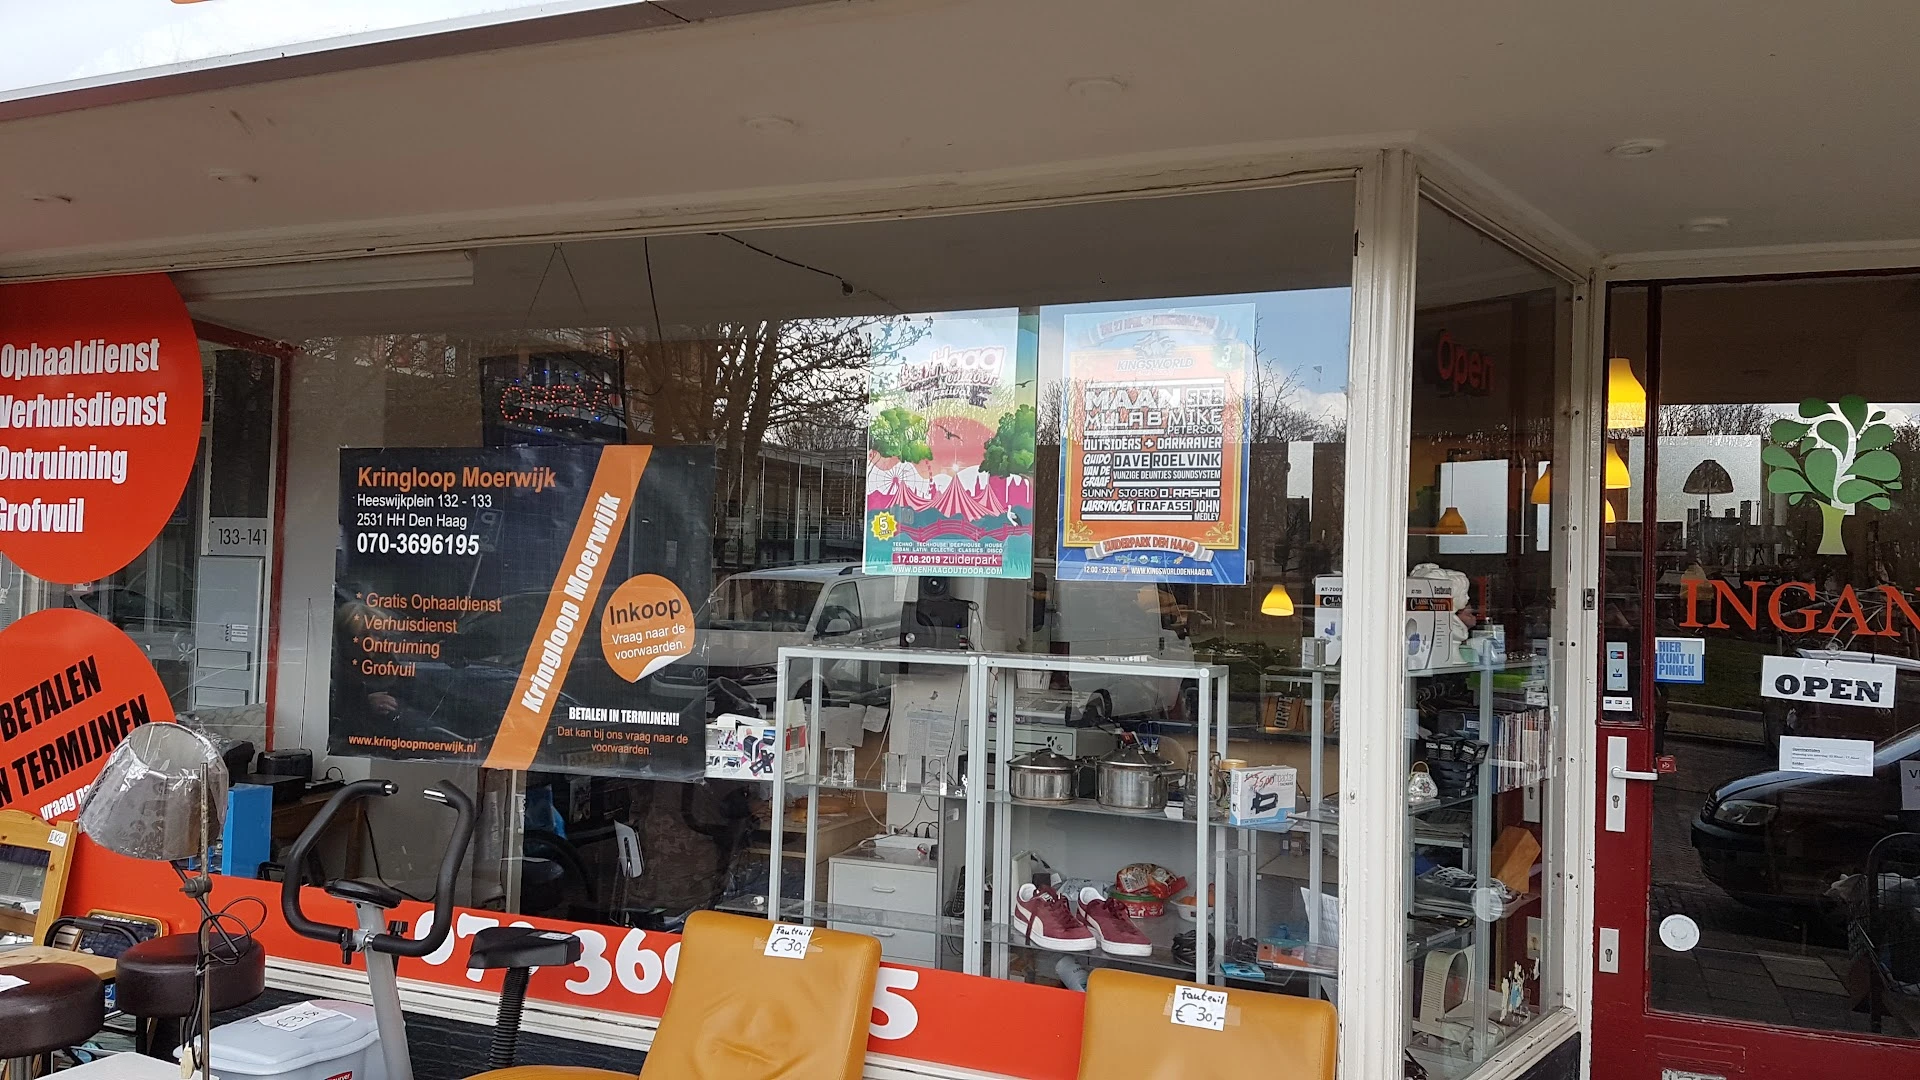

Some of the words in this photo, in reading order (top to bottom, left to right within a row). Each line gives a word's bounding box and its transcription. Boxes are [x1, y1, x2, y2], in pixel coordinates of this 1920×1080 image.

[1, 338, 160, 380] Ophaaldienst
[1223, 345, 1232, 361] 3
[1116, 357, 1194, 371] KINGSWORLD
[1438, 332, 1496, 392] Open
[500, 384, 600, 420] OPEN
[1085, 388, 1181, 411] MAAN
[0, 392, 167, 428] Verhuisdienst
[1167, 407, 1223, 426] MIKE
[1167, 424, 1222, 434] PETERSON
[1083, 436, 1142, 451] OUTSIDERS
[1156, 436, 1222, 450] DARKRAVER
[0, 445, 128, 484] Ontruiming
[1115, 453, 1151, 467] DAVE
[1152, 453, 1221, 467] ROELVINK
[358, 467, 457, 492] Kringloop
[462, 466, 556, 492] Moerwijk
[1083, 465, 1099, 476] VAN
[1100, 465, 1110, 475] DE
[1113, 470, 1140, 479] VUNZIGE
[1141, 470, 1172, 480] DEUNTJES
[1173, 470, 1220, 480] SOUNDSYSTEM
[1082, 476, 1110, 487] GRAAF
[357, 494, 434, 509] Heeswijkplein
[438, 494, 459, 508] 132
[470, 495, 492, 508] 133
[1081, 488, 1114, 498] SUNNY
[1118, 488, 1157, 498] SJOERD
[1138, 501, 1192, 511] TRAFASSI
[1194, 500, 1219, 512] JOHN
[357, 513, 382, 527] 2531
[386, 513, 405, 527] HH
[409, 513, 432, 527] Den
[436, 514, 468, 530] Haag
[879, 516, 888, 531] 5
[219, 529, 267, 545] 133-141
[357, 532, 480, 555] 070-3696195
[1104, 536, 1151, 552] ZUIDERPARK
[1153, 536, 1169, 549] DEN
[1170, 537, 1195, 553] HAAG
[897, 555, 940, 564] 17.08.2019
[943, 555, 998, 566] zuiderpark
[892, 565, 1003, 575] WWW.DENHAAGOUTDOOR.COM
[1131, 567, 1213, 576] WWW.KINGSWORLDDENHAAG.NL
[366, 592, 407, 610] Gratis
[411, 594, 502, 613] Ophaaldienst
[521, 599, 580, 714] Kringloop
[570, 492, 621, 602] Moerwijk
[1680, 580, 1920, 637] INGAN
[609, 598, 682, 626] Inkoop
[363, 615, 457, 633] Verhuisdienst
[611, 629, 643, 645] Vraag
[645, 626, 670, 640] naar
[671, 622, 686, 636] de
[362, 637, 440, 658] Ontruiming
[614, 638, 686, 661] voorwaarden.
[1659, 641, 1681, 652] HIER
[1659, 653, 1685, 664] KUNT
[1688, 654, 1695, 664] U
[361, 659, 415, 677] Grofvuil
[1659, 665, 1695, 676] PINNEN
[1775, 674, 1882, 703] OPEN
[0, 654, 102, 742] BETALEN
[569, 706, 607, 722] BETALEN
[609, 708, 620, 722] IN
[621, 708, 680, 726] TERMIJNEN!!
[348, 734, 477, 753] www.kringloopmoerwijk.nl
[557, 726, 573, 737] Dat
[575, 727, 592, 738] kan
[594, 728, 605, 742] bij
[607, 731, 623, 741] ons
[625, 732, 652, 745] vraag
[653, 733, 675, 744] naar
[677, 732, 689, 744] de
[591, 742, 652, 756] voorwaarden.
[40, 793, 76, 820] vraag
[776, 926, 812, 936] Fauteuil
[1182, 988, 1225, 1004] Fauteuil
